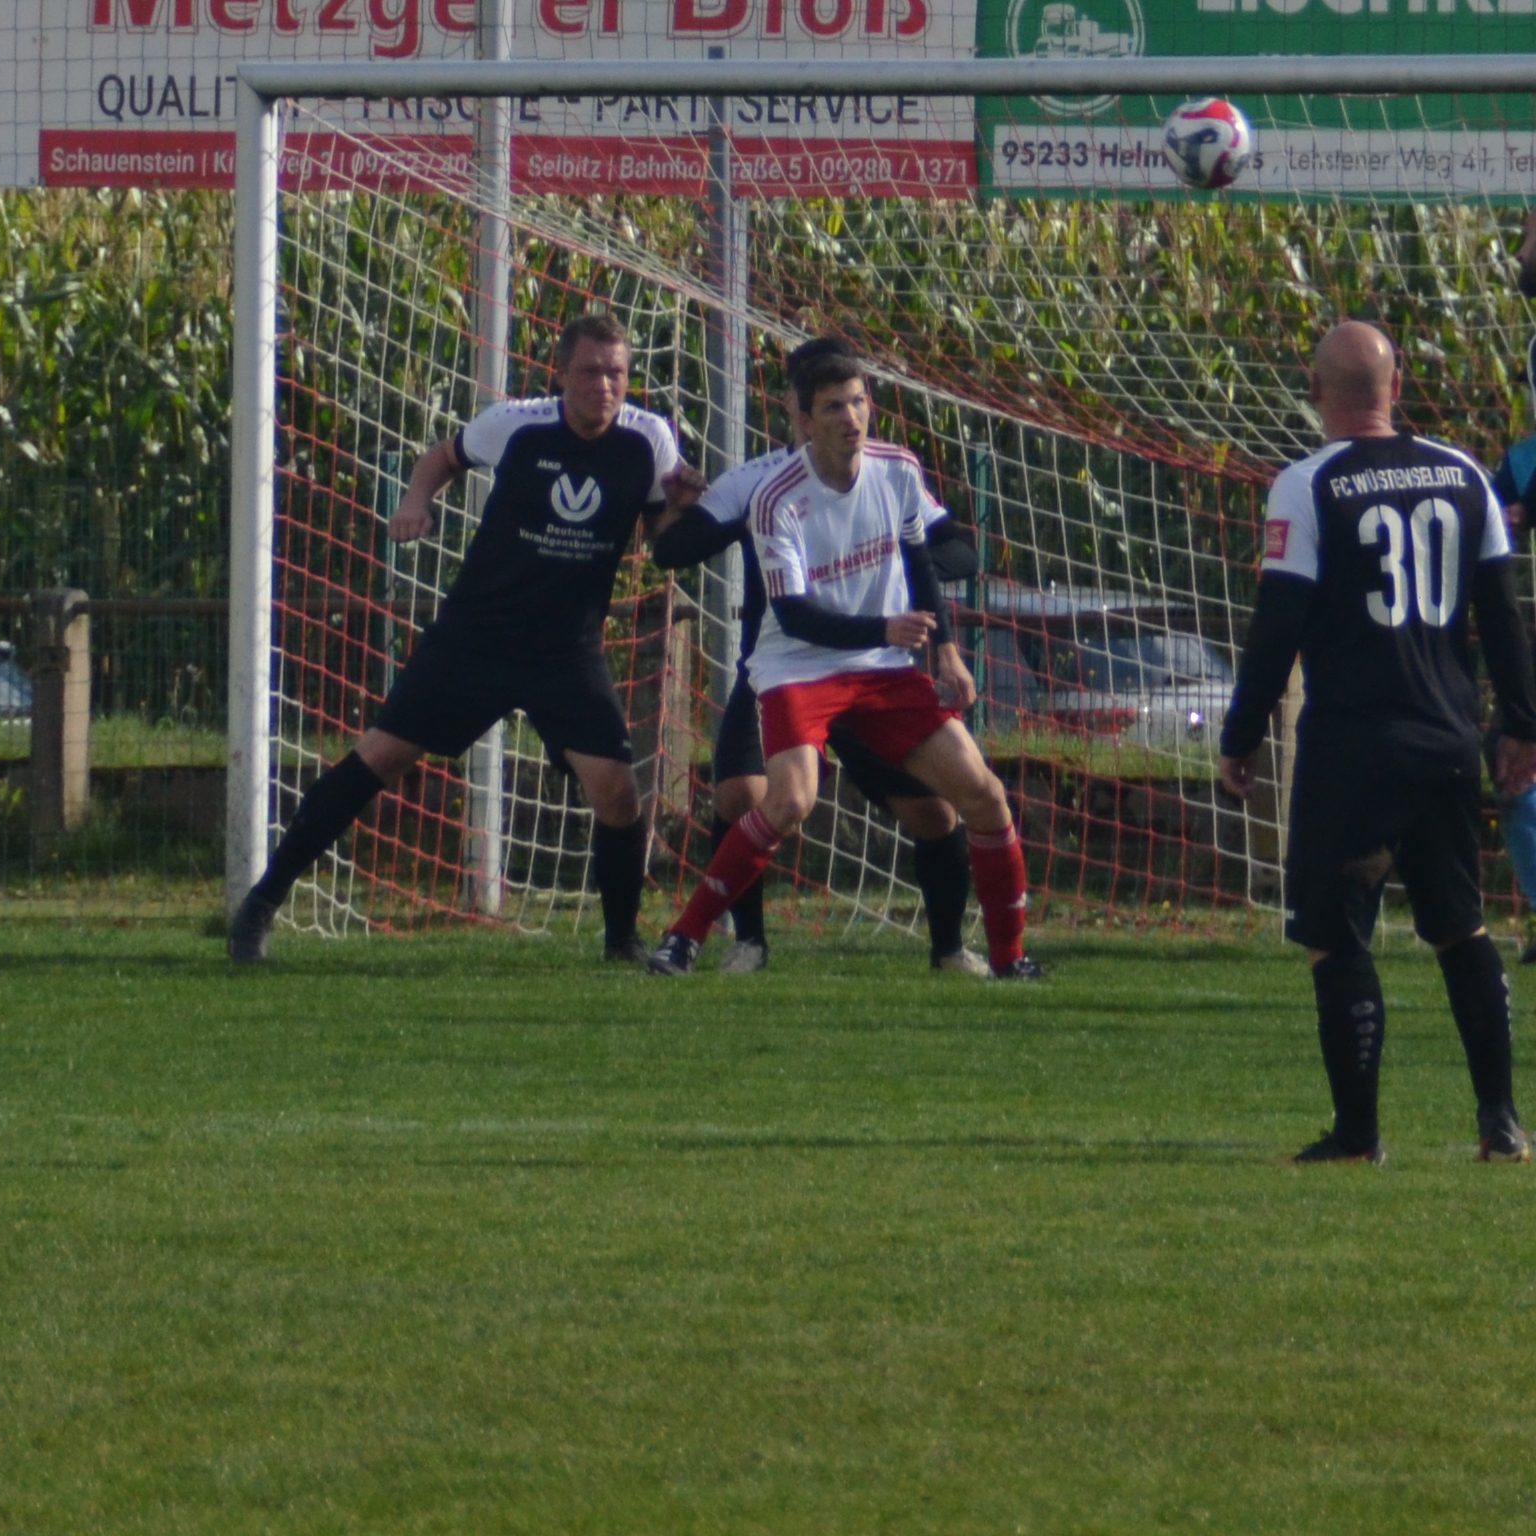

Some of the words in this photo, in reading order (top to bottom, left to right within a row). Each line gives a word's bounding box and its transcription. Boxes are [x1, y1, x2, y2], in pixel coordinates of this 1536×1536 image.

[736, 96, 920, 125] SERVICE
[51, 148, 196, 173] Schauenstein
[528, 154, 601, 179] Selbitz
[1002, 140, 1089, 168] 95233
[1400, 146, 1452, 180] Weg
[1329, 476, 1354, 500] FC
[1353, 466, 1467, 495] WÜSTENSELBITZ
[1357, 497, 1461, 628] 30
